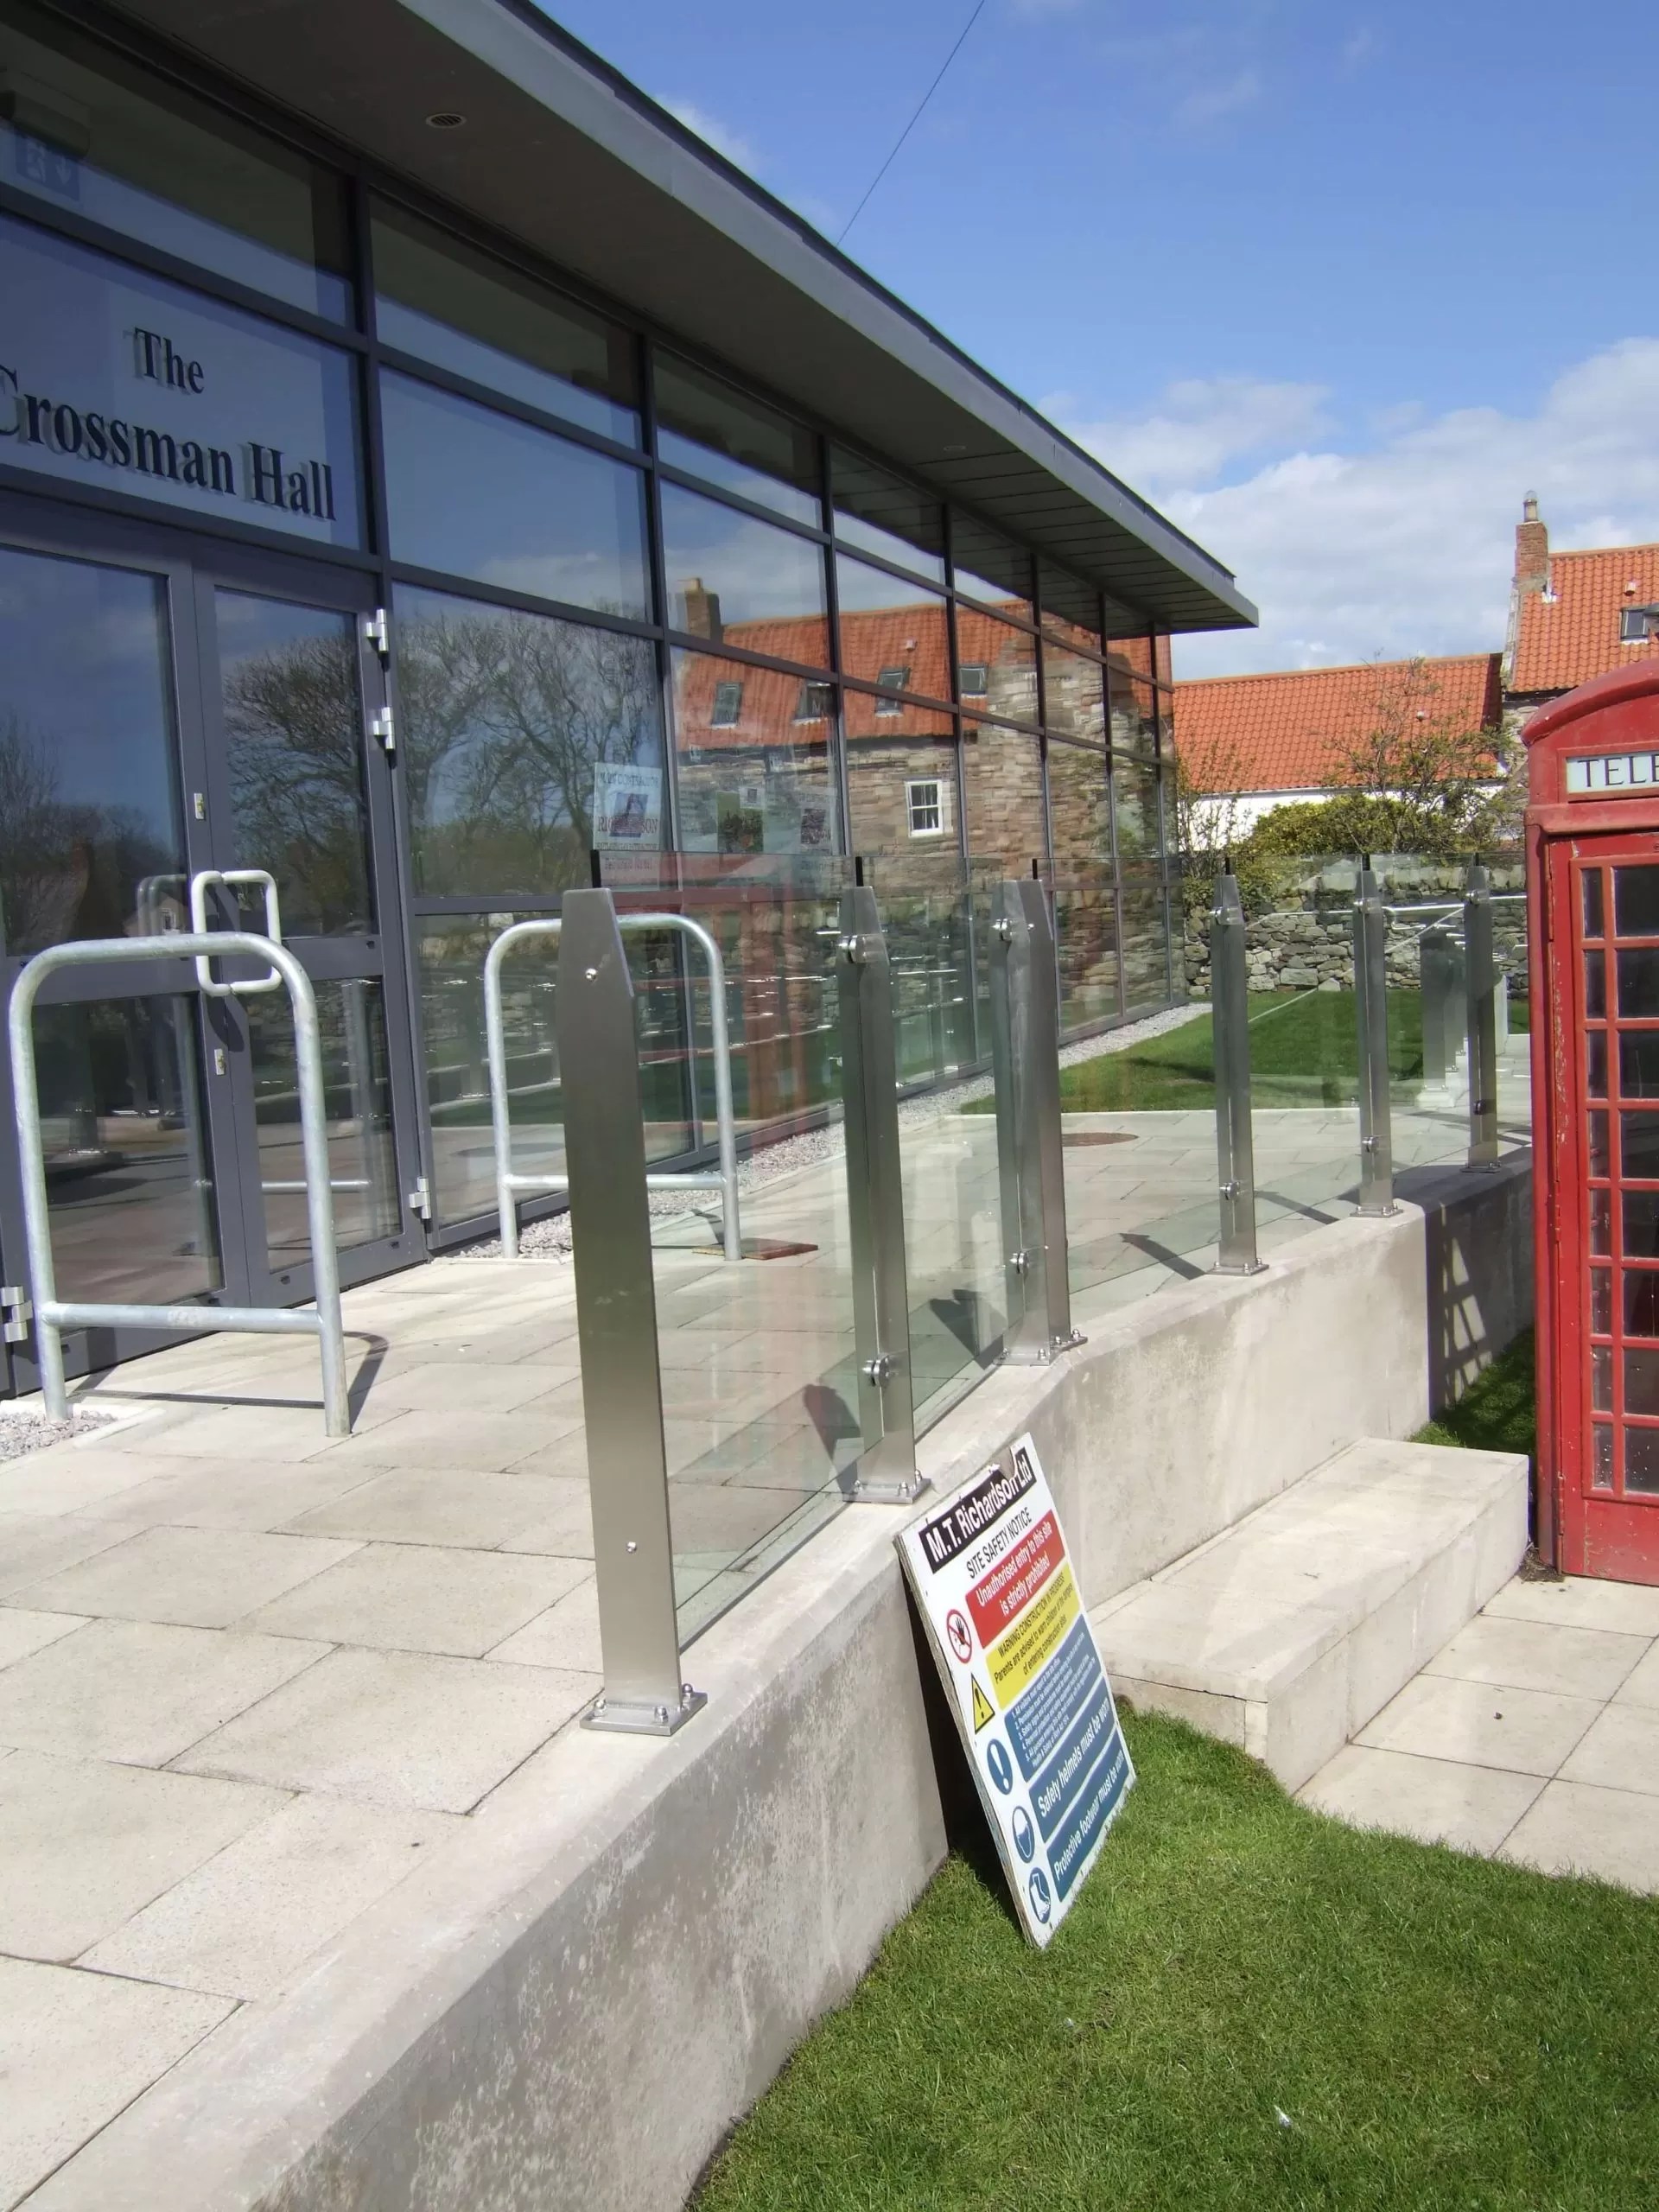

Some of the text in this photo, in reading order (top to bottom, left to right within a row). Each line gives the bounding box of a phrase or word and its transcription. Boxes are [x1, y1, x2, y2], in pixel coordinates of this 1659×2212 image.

[135, 327, 205, 394] The
[249, 442, 336, 521] Hall
[925, 1454, 1033, 1562] M.T. Richardson Ltd
[966, 1506, 1033, 1580] SITE SAFETY NOTICE
[976, 1520, 1052, 1609] Unauthorised entry to this site
[999, 1550, 1050, 1617] is strictly prohibited
[994, 1660, 1014, 1685] Parents
[1012, 1651, 1021, 1667] are
[1019, 1632, 1035, 1658] advised
[1033, 1630, 1039, 1642] to
[997, 1627, 1021, 1659] WARNING
[1018, 1594, 1048, 1637] CONSTRUCTION
[1022, 1662, 1029, 1676] of
[1027, 1646, 1045, 1670] entering
[1037, 1696, 1110, 1818] Safety helmets must be worn
[1053, 1749, 1124, 1882] Protective footwear must be worn
